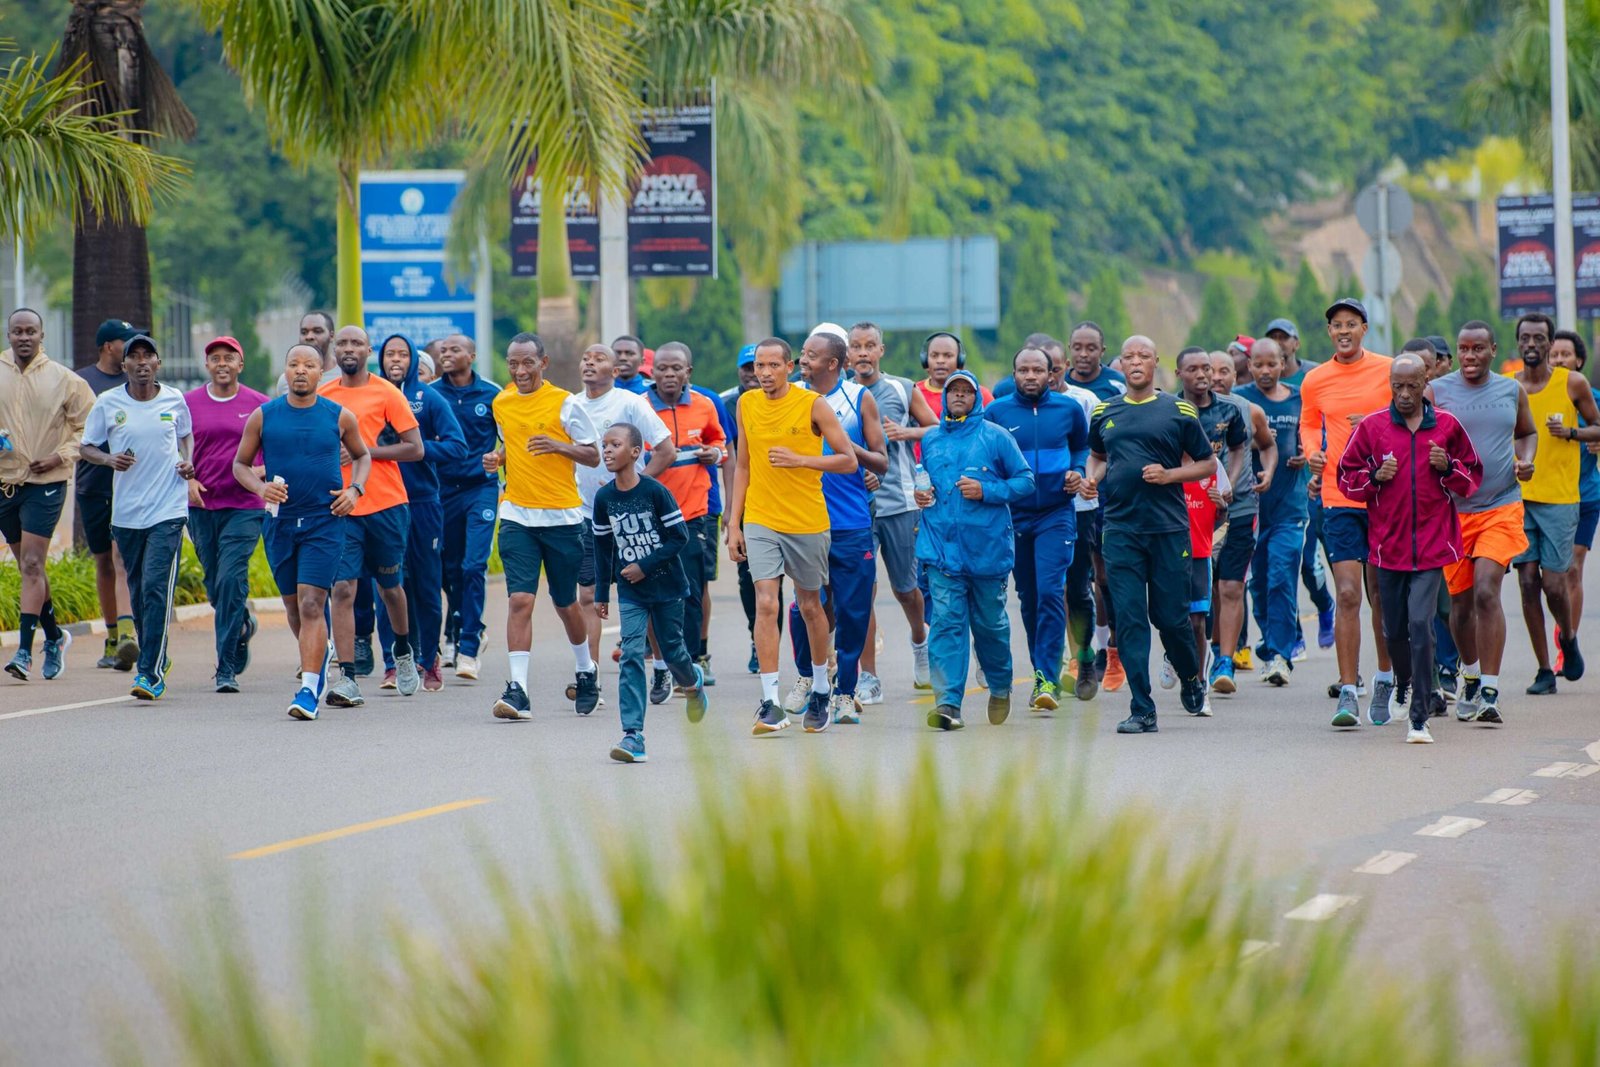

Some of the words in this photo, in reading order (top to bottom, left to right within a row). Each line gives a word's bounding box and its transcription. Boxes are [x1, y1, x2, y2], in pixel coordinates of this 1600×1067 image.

[641, 174, 698, 191] MOVE
[633, 190, 706, 207] AFRIKA
[626, 530, 660, 547] THIS
